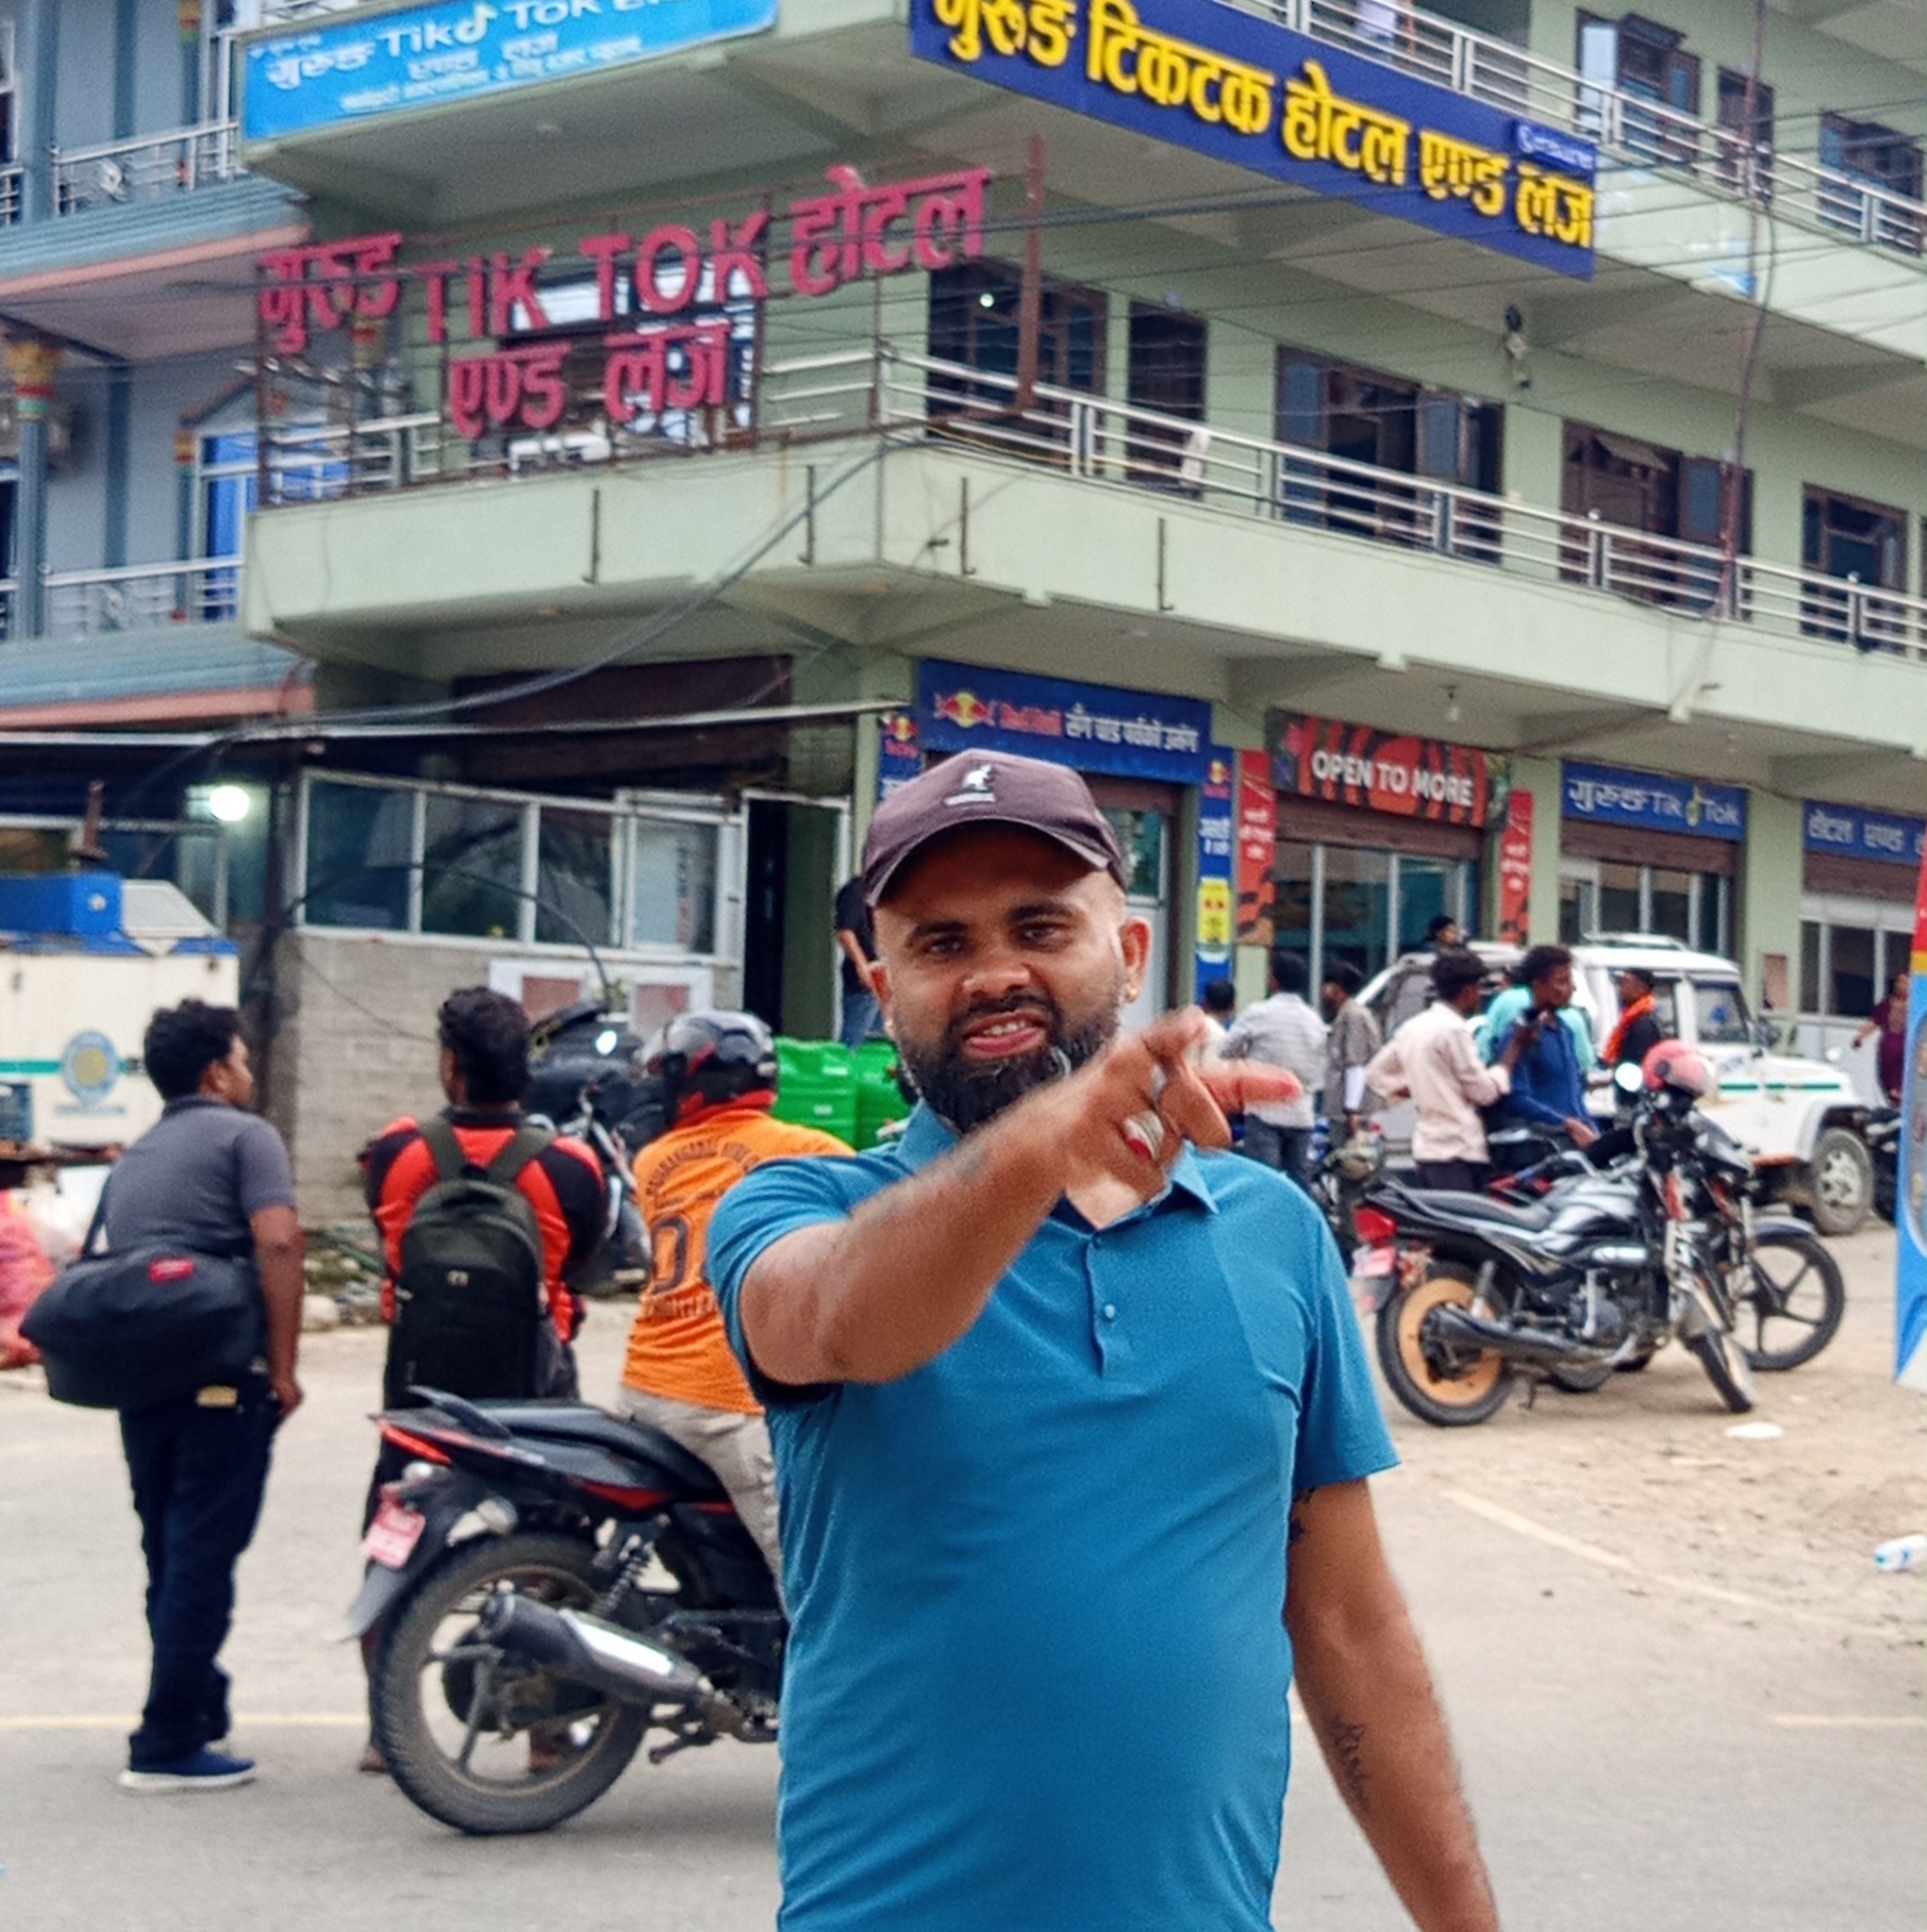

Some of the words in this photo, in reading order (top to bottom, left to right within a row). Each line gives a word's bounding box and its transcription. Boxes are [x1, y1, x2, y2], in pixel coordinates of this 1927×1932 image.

[1087, 0, 1275, 134] टिकटक
[1282, 57, 1411, 186] होटल
[1420, 127, 1511, 202] एण्ड
[1515, 161, 1596, 249] लज
[409, 244, 557, 345] TIK
[578, 208, 772, 323] TOK
[789, 162, 1000, 297] होटल
[447, 341, 573, 440] एण्ड
[603, 317, 731, 423] लज
[1311, 750, 1373, 789] OPEN
[1376, 762, 1407, 794] TO
[1413, 767, 1474, 808] MORE
